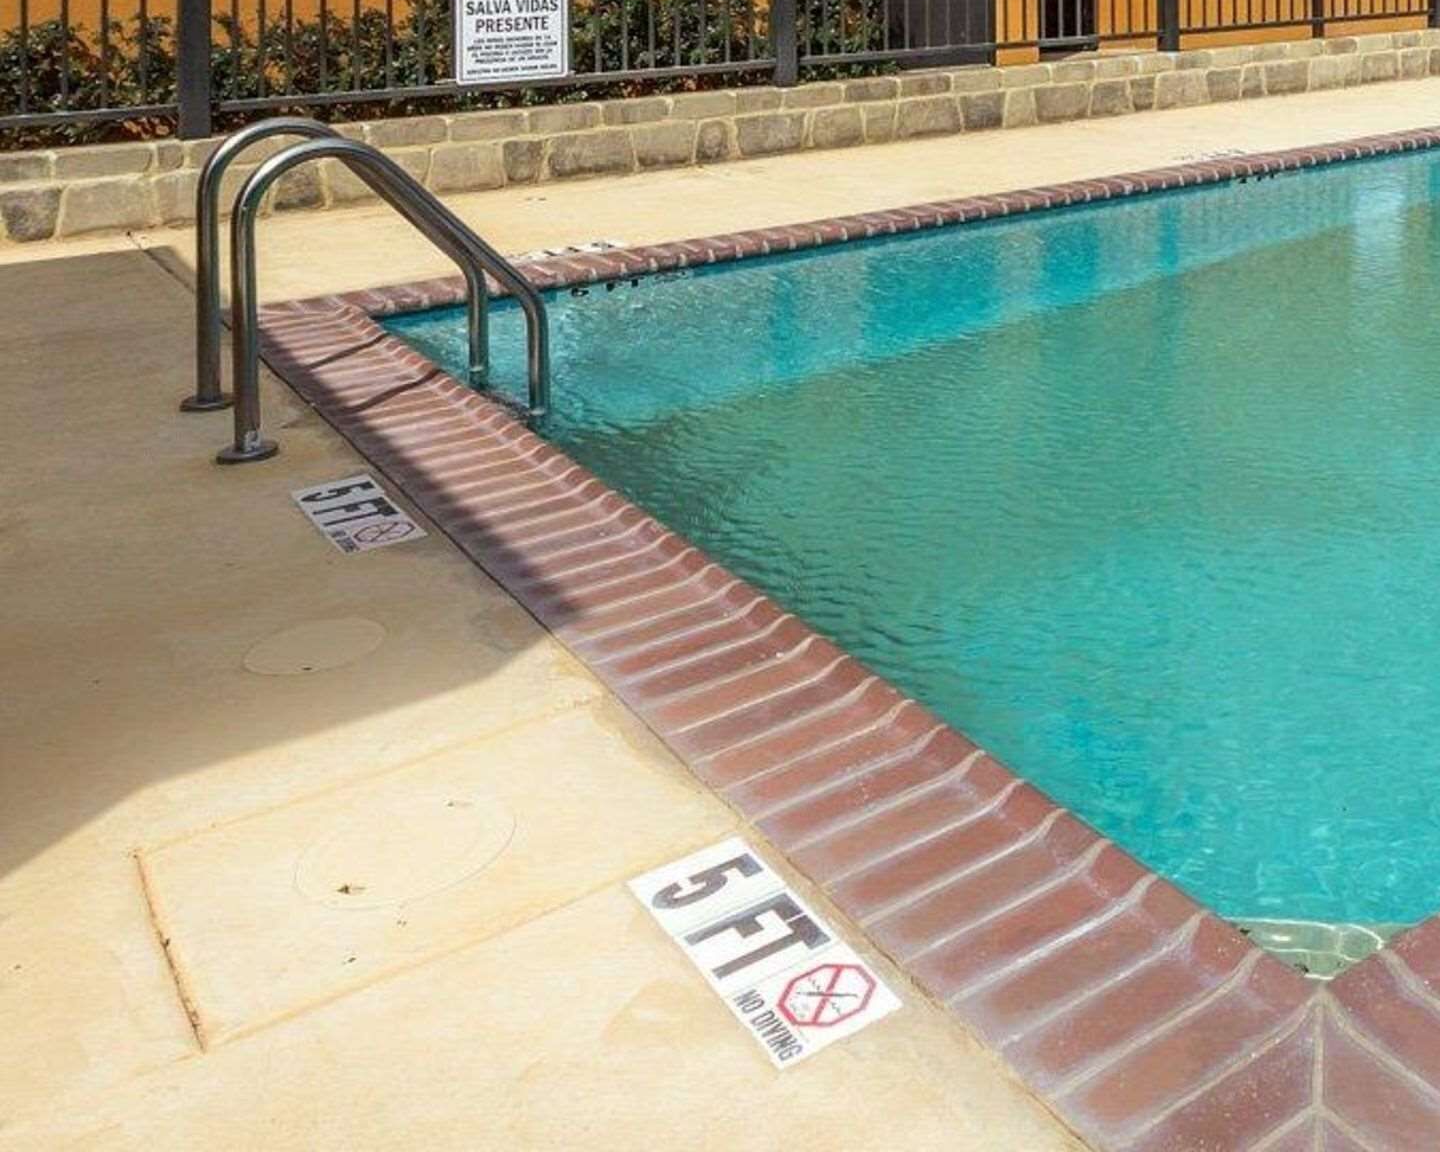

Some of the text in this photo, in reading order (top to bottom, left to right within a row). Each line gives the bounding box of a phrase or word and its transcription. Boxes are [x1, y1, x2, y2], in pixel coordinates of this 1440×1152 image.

[466, 0, 512, 16] SALVA
[475, 16, 550, 33] PRESENTE
[301, 480, 400, 527] 5 FT
[651, 852, 832, 981] 5 FT
[733, 989, 804, 1062] NO DIVING
